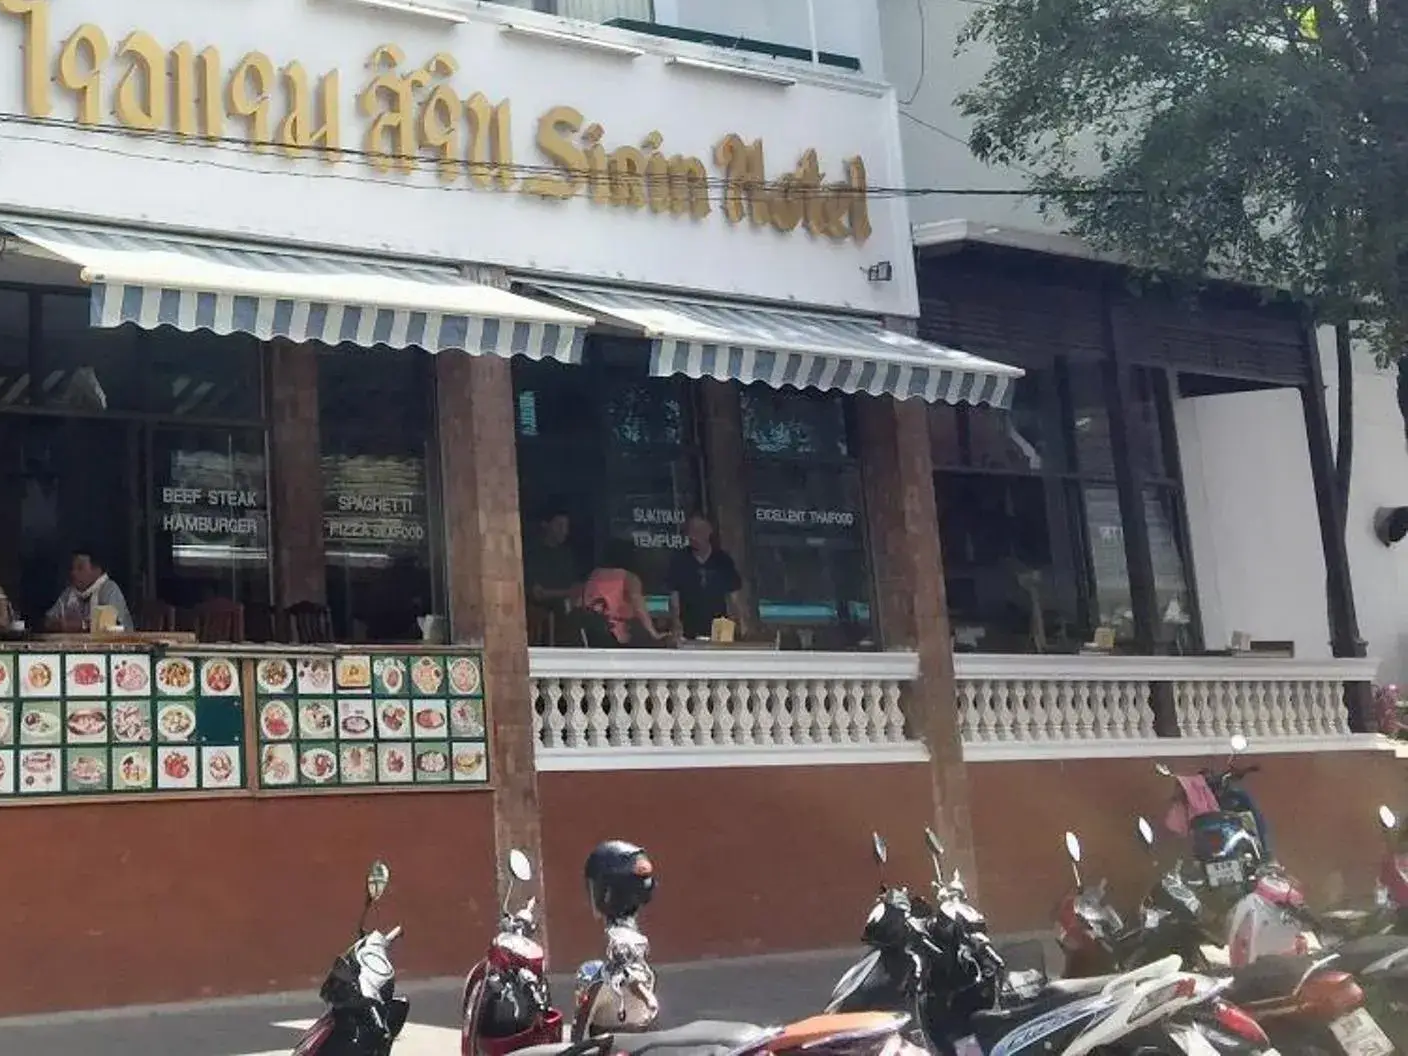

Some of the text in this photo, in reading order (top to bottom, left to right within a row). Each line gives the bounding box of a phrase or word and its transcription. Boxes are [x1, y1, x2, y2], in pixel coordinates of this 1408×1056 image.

[712, 132, 873, 246] Hotel
[162, 487, 258, 507] BEEF STEAK
[162, 512, 258, 535] HAMBURGER
